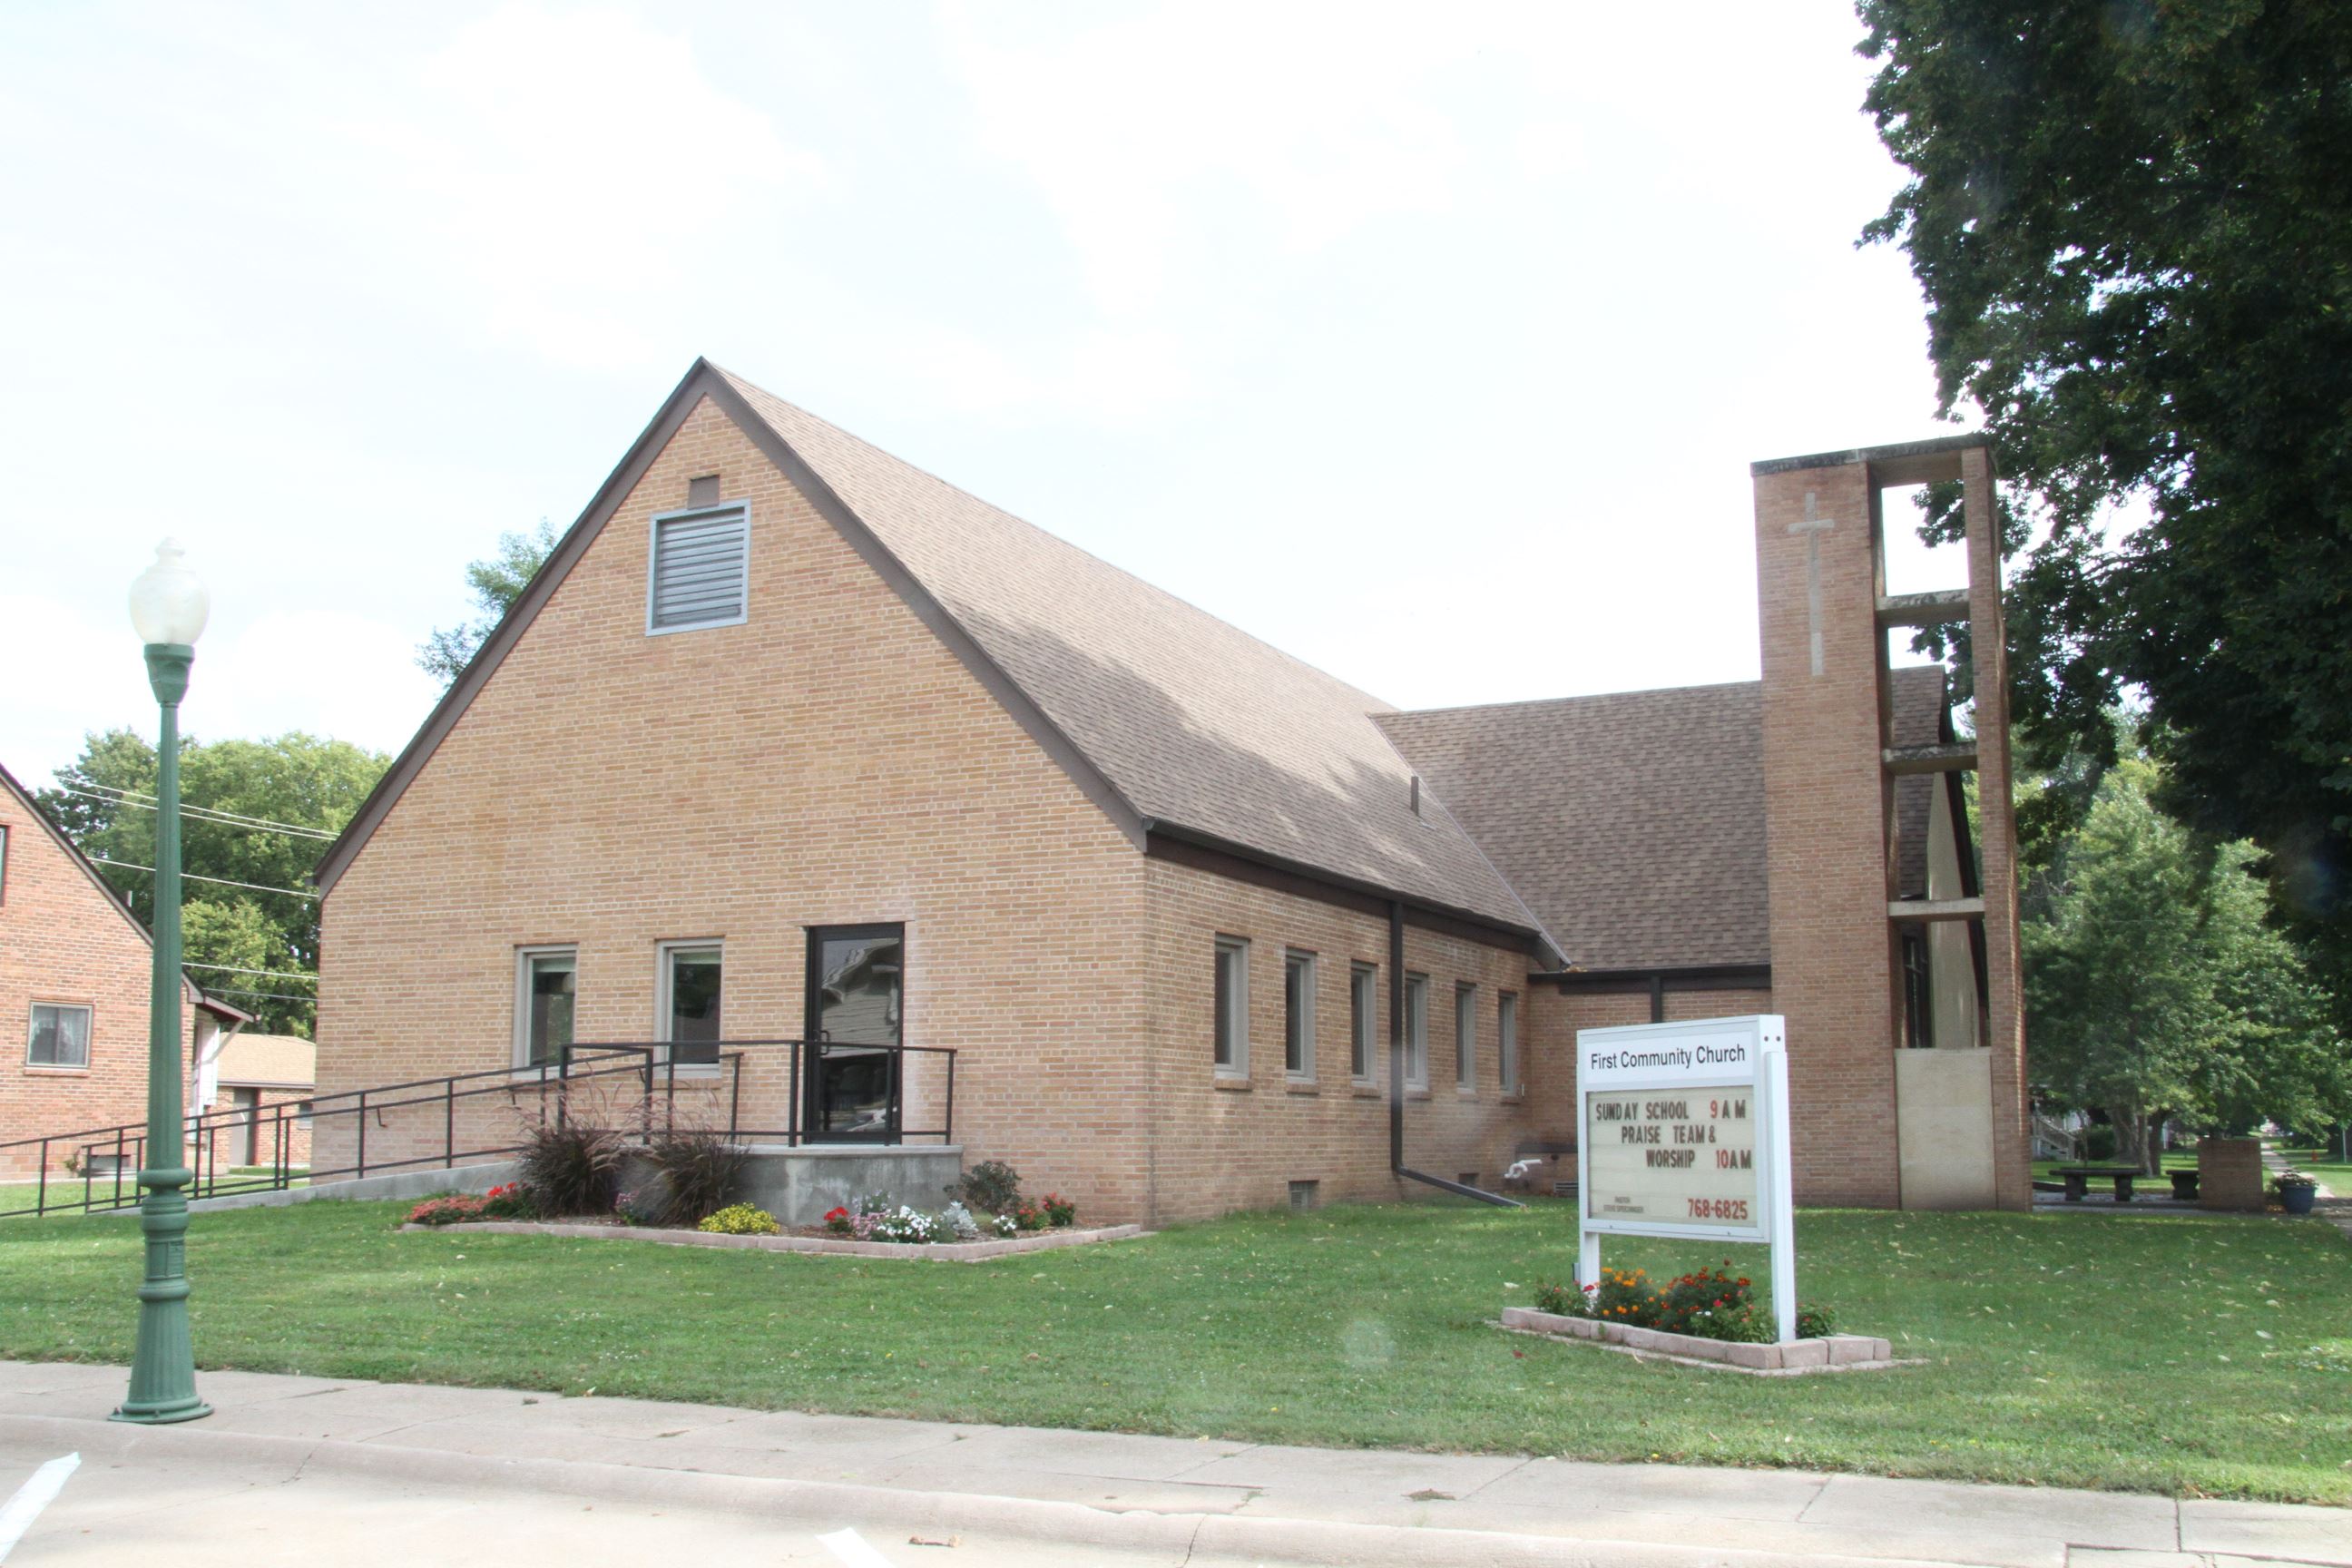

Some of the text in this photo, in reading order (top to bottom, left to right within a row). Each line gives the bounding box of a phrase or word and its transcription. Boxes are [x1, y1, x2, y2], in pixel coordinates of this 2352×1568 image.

[1591, 1044, 1745, 1070] First Community Church
[1596, 1102, 1639, 1122] SUNDAY
[1646, 1101, 1690, 1121] SCHOOL
[1710, 1100, 1718, 1119] 9
[1622, 1124, 1716, 1144] PRAISE TEAM &
[1646, 1149, 1696, 1169] WORSHIP
[1687, 1198, 1749, 1220] 768-6825
